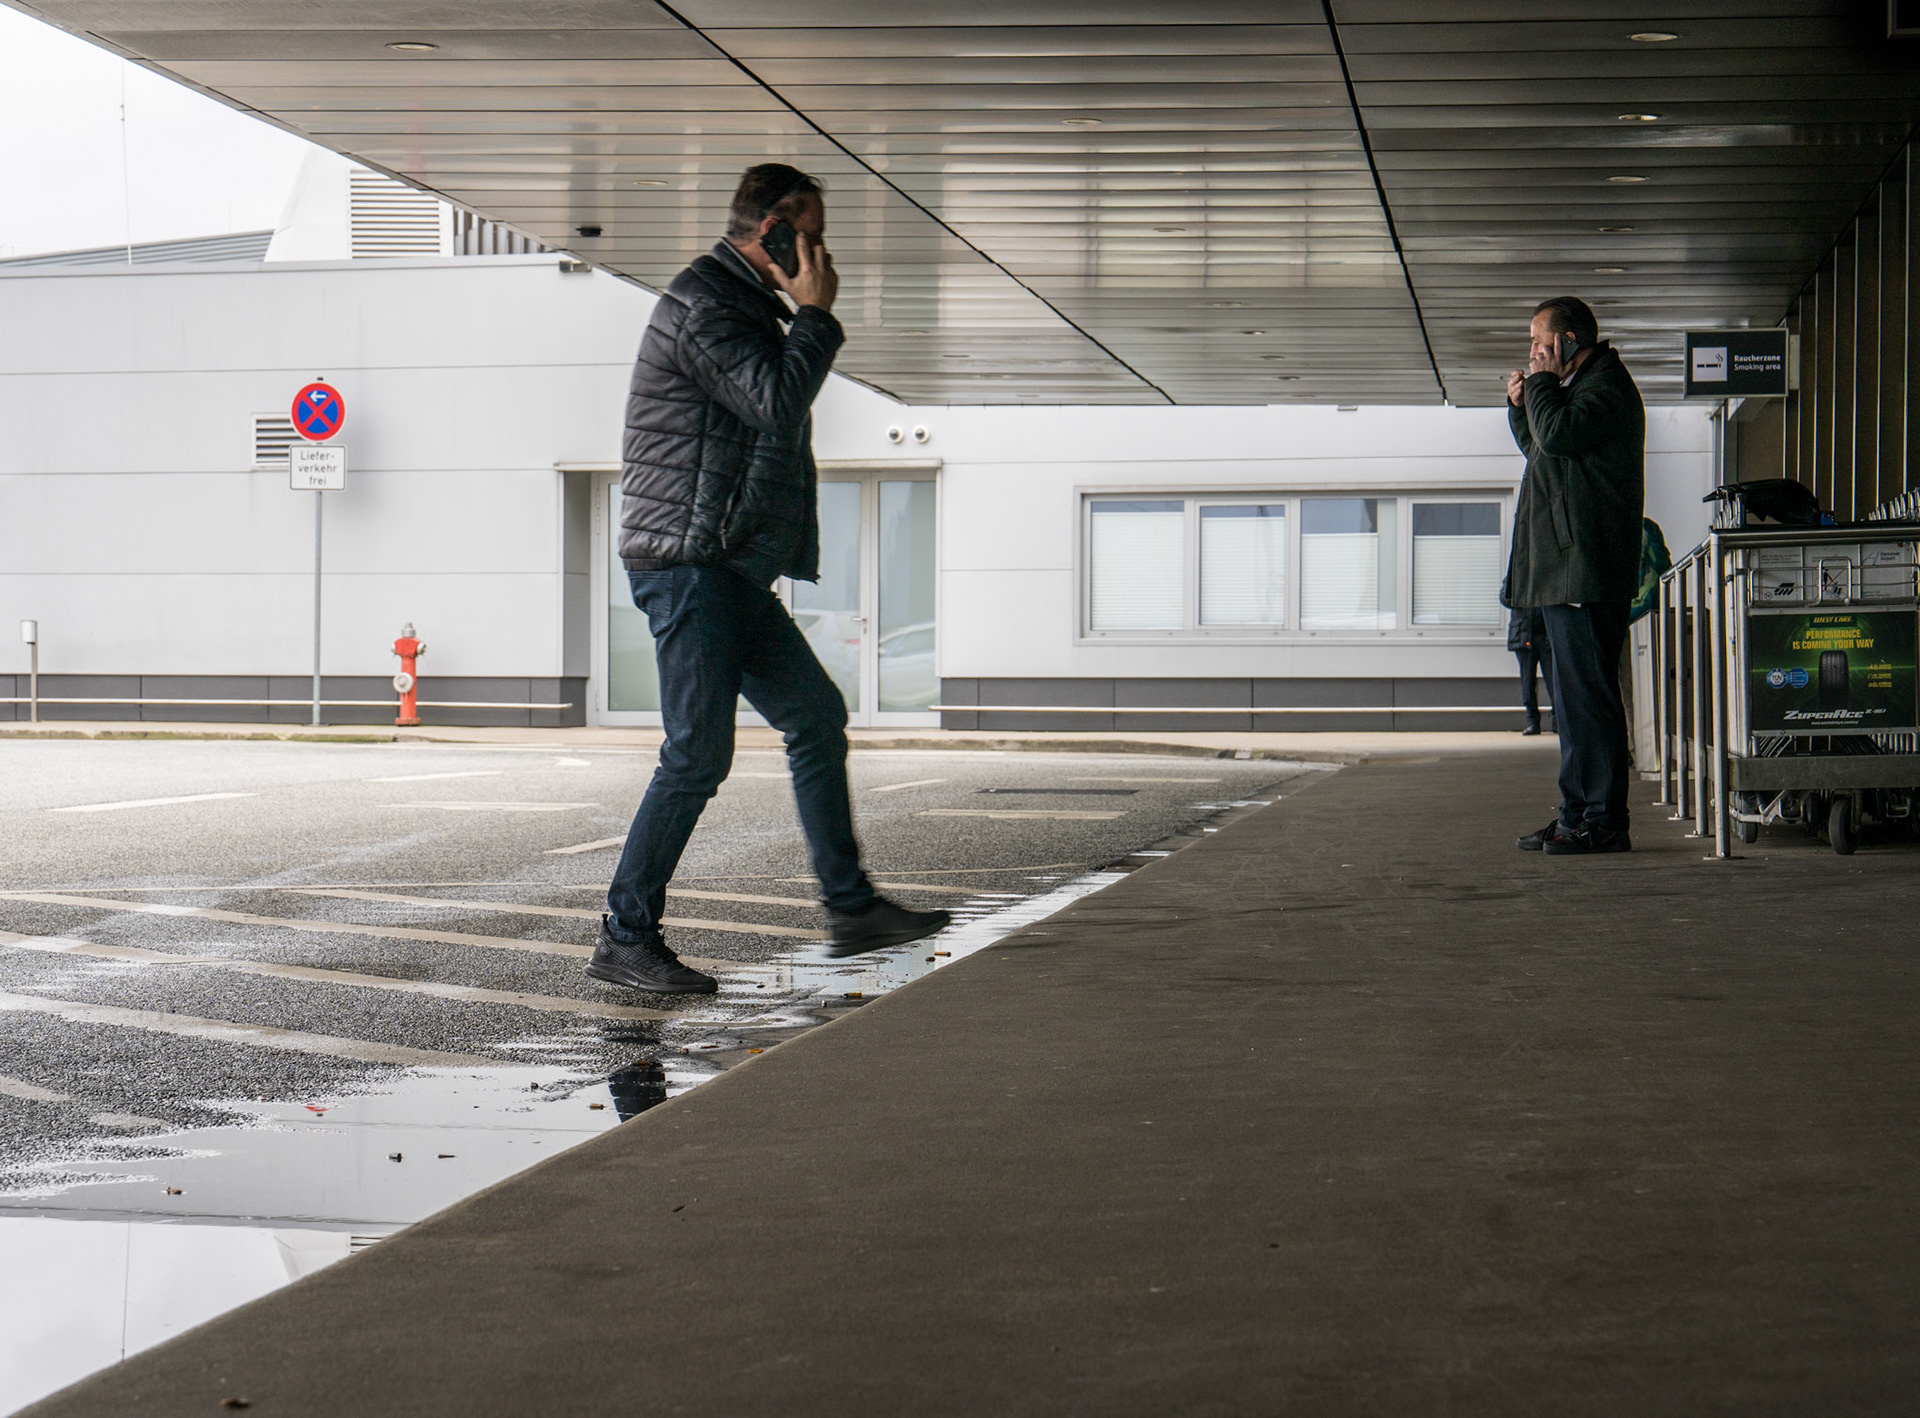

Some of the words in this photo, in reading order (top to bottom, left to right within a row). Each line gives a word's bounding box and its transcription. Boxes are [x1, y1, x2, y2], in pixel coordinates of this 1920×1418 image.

[1734, 354, 1781, 362] Raucherzone
[1734, 363, 1764, 372] Smoking
[300, 450, 335, 460] Liefer-
[298, 462, 338, 472] verkehr
[309, 475, 327, 486] frei
[1805, 629, 1861, 639] PERFORMANCE
[1792, 640, 1800, 650] IS
[1801, 640, 1832, 649] COMING
[1833, 639, 1854, 649] YOUR
[1855, 638, 1875, 648] WAY
